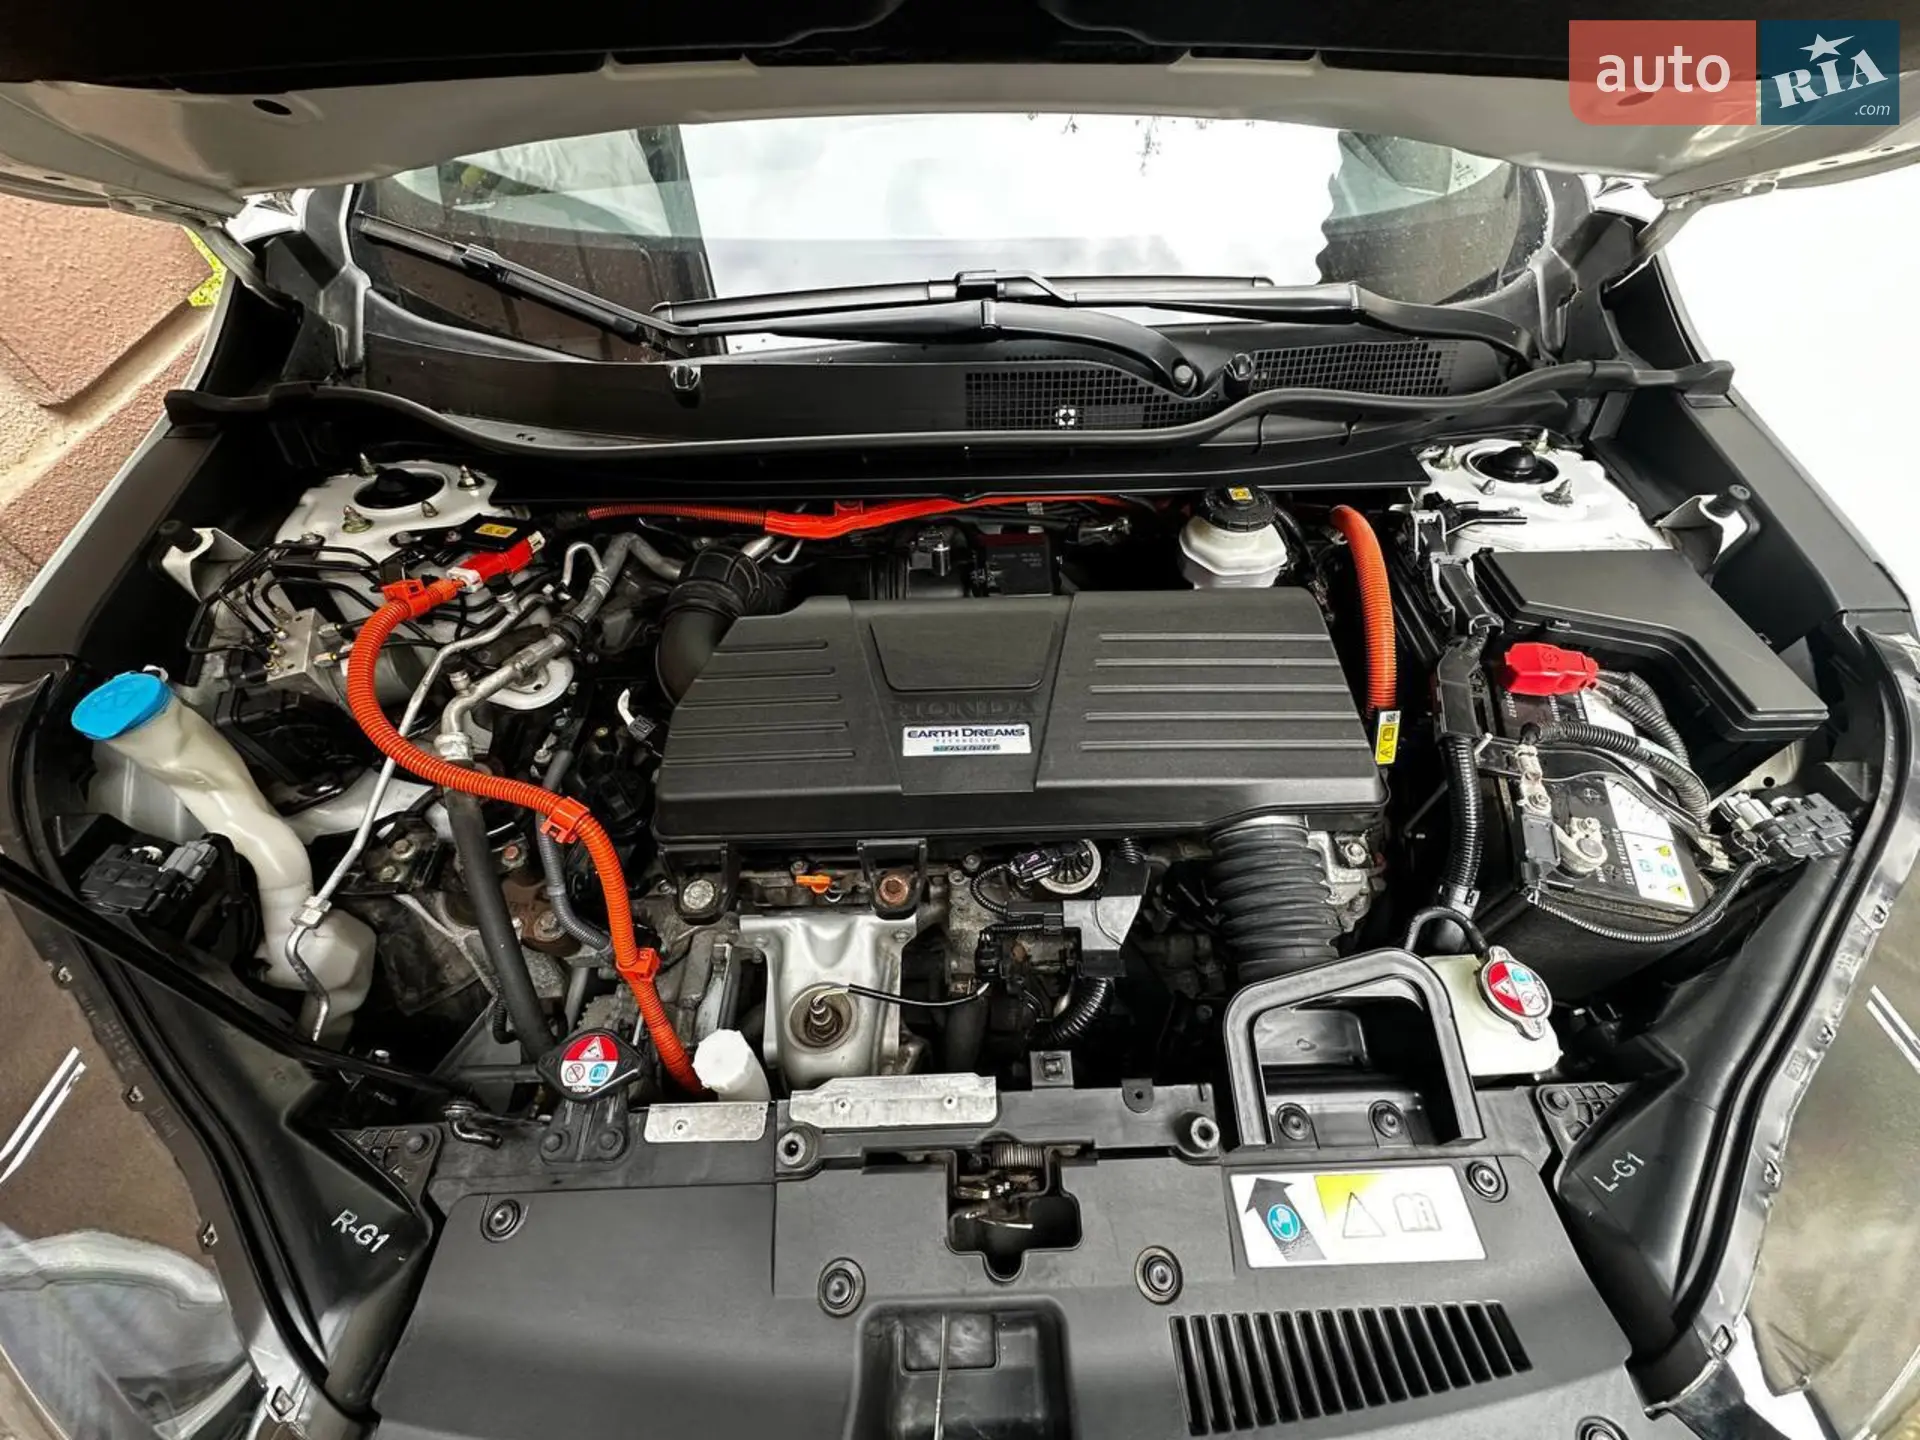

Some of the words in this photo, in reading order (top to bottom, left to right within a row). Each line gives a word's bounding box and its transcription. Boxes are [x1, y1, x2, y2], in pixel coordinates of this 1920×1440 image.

[907, 730, 959, 739] EARTH
[961, 727, 1026, 739] DREAMS
[1593, 1151, 1644, 1192] L-G1
[331, 1209, 390, 1253] R-G1
